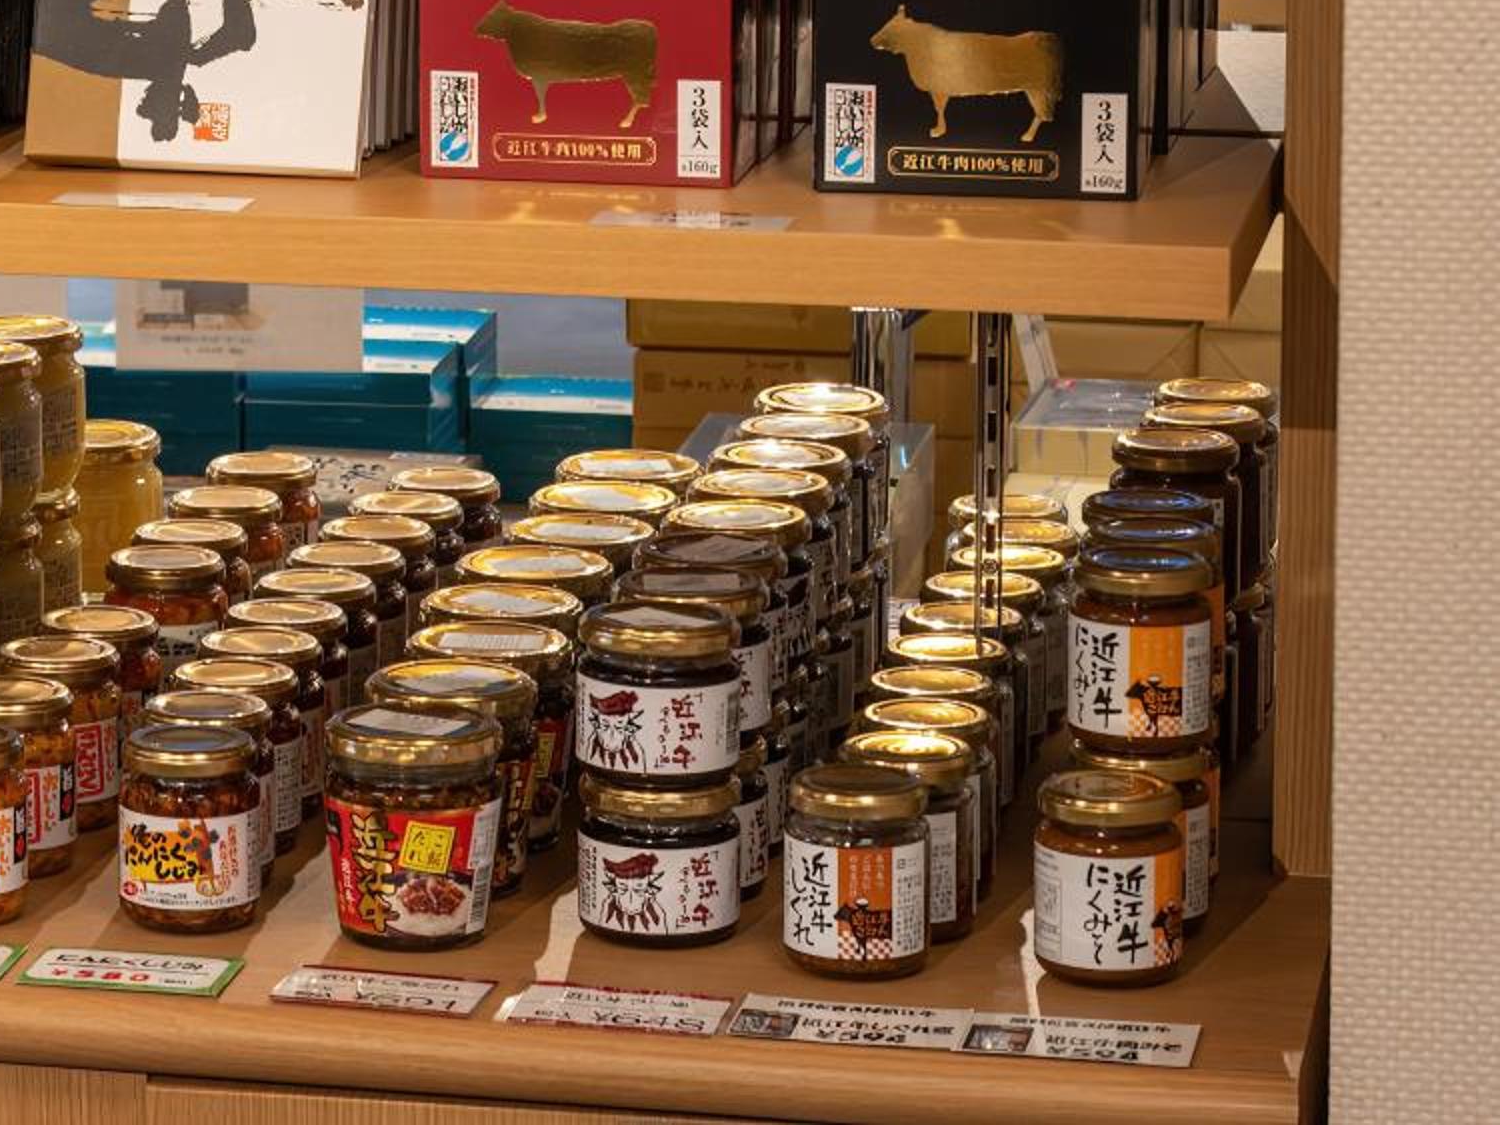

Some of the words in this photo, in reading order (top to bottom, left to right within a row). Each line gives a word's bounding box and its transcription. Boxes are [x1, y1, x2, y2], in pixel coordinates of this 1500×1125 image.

[691, 87, 709, 150] 3袋入
[1095, 101, 1115, 164] 3袋入
[507, 141, 642, 160] 近江牛肉100%使用
[902, 154, 1045, 173] 近江牛肉100%使用
[1092, 633, 1122, 728] 近江牛
[125, 843, 186, 866] にんにく
[156, 861, 204, 880] しじみ
[790, 867, 814, 946] しぐれ
[802, 852, 832, 933] 近江牛
[1115, 863, 1148, 965] 近江牛
